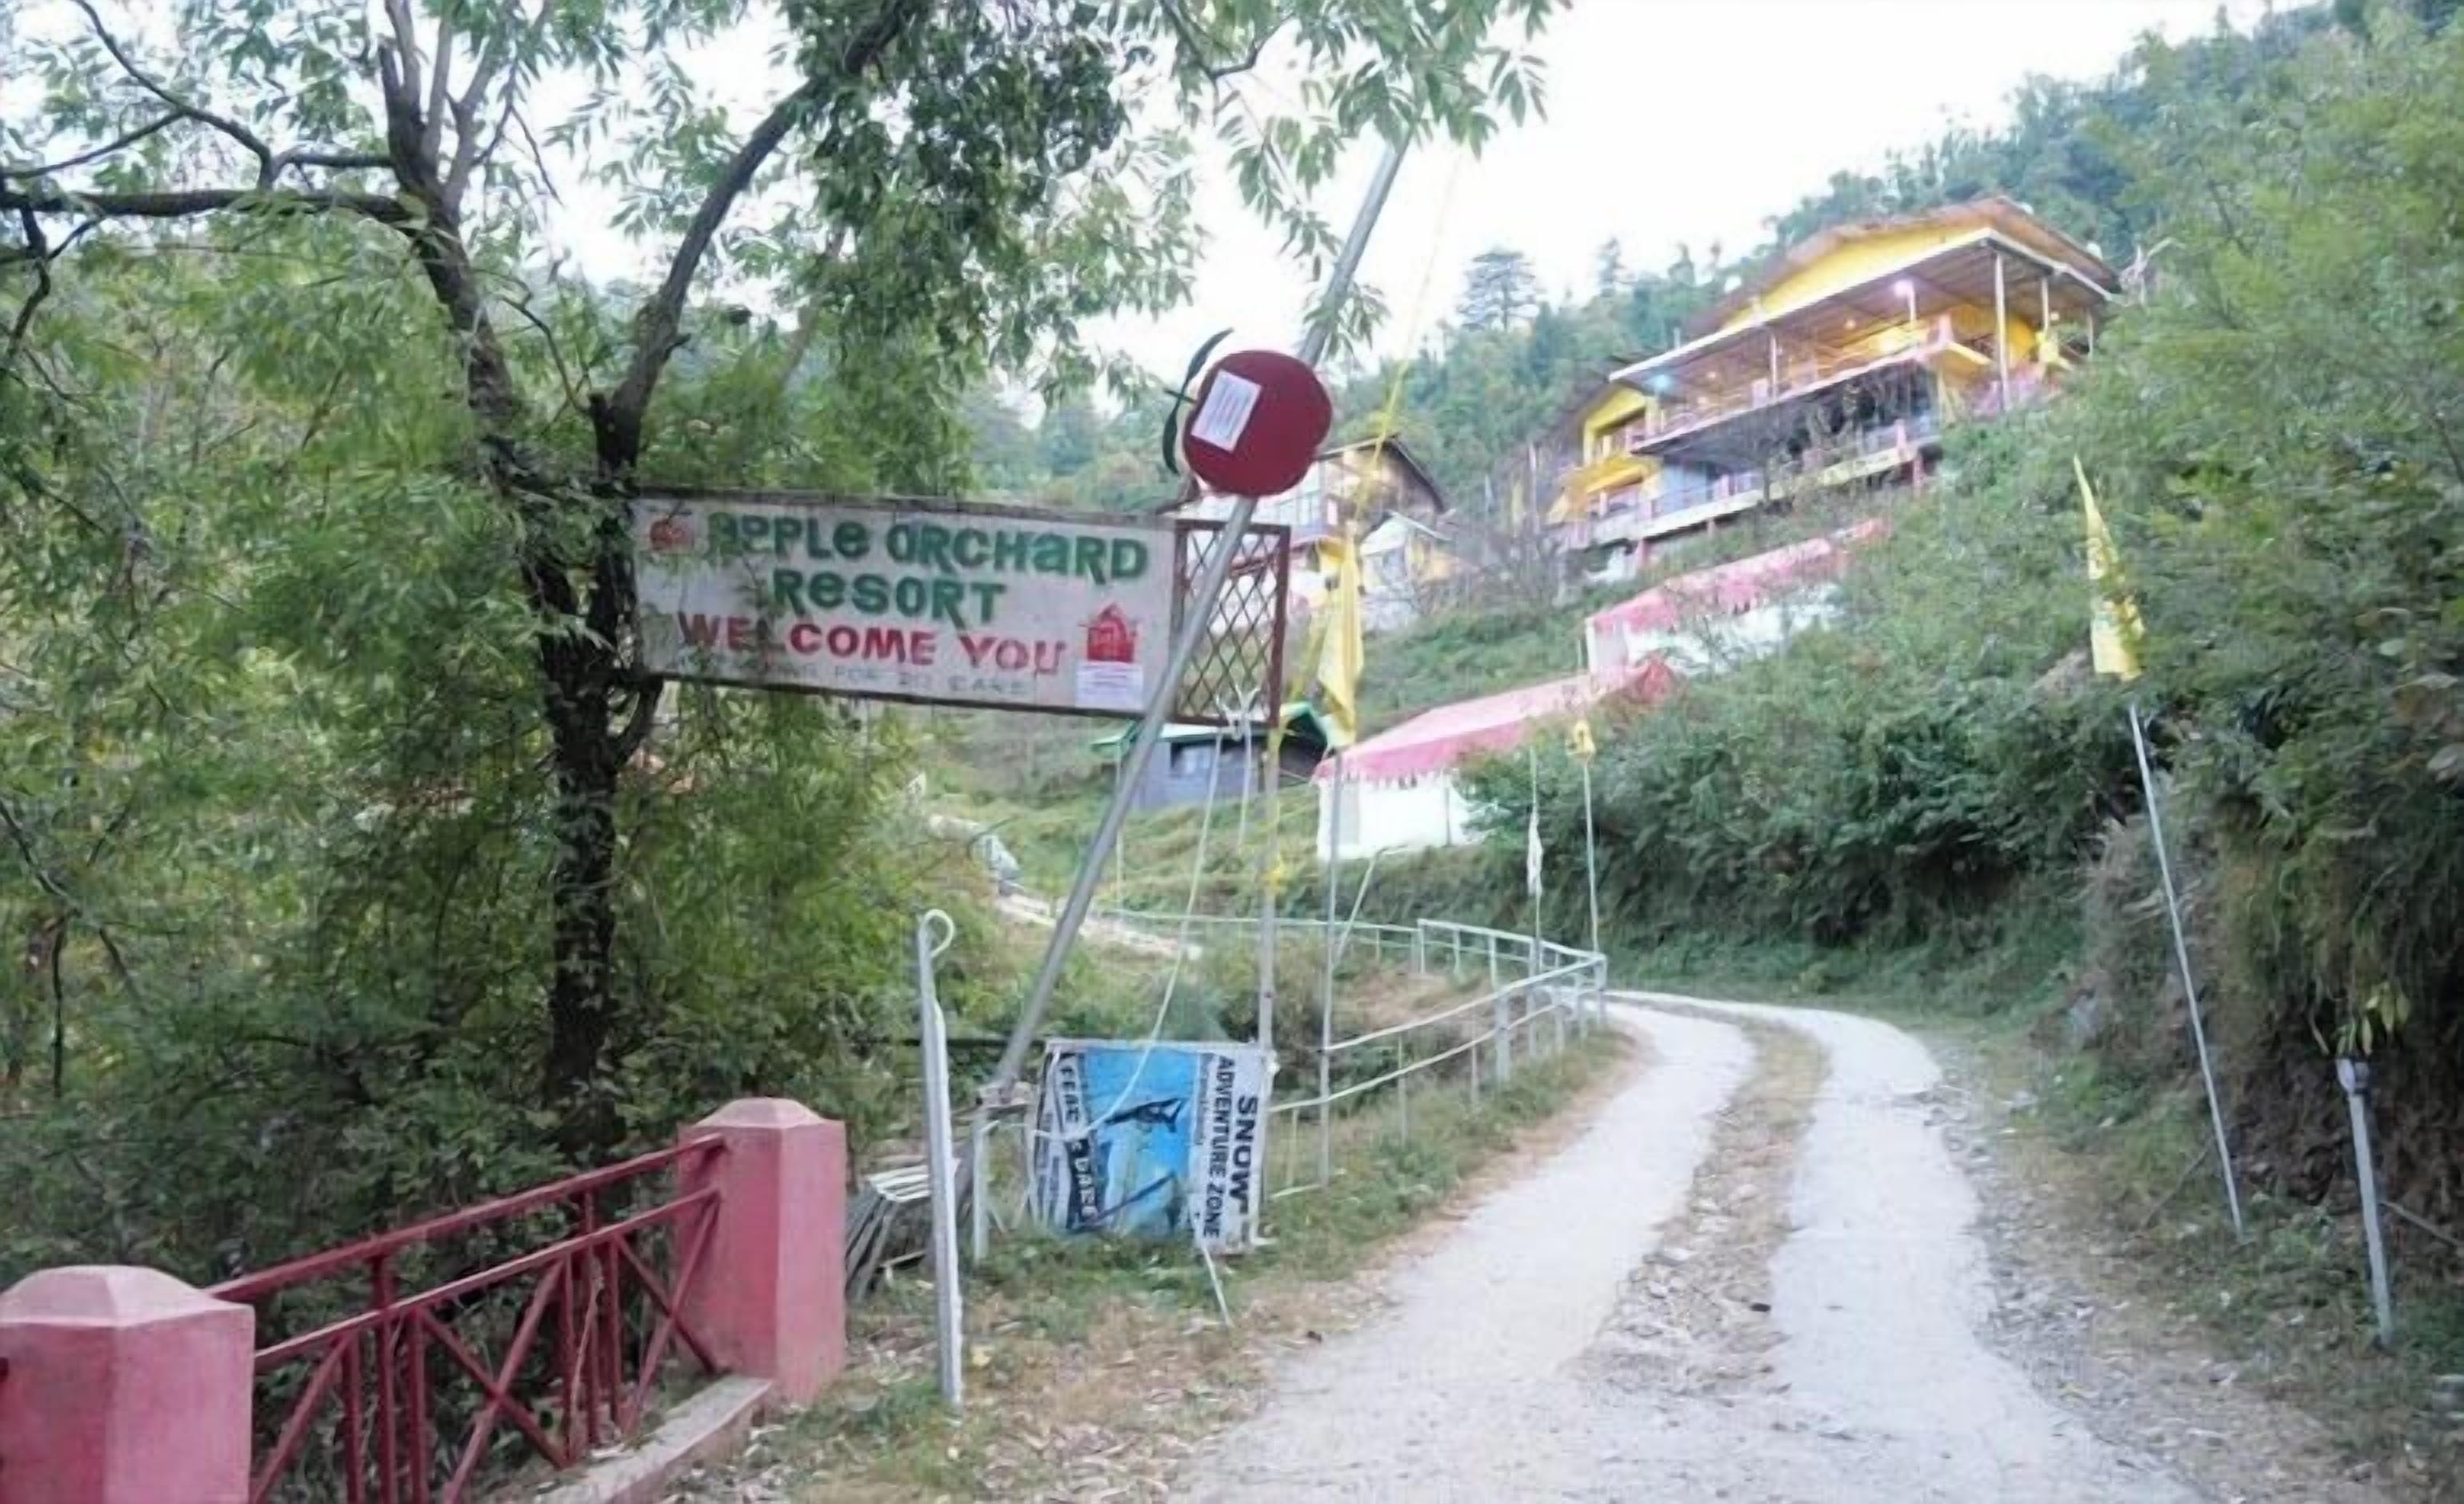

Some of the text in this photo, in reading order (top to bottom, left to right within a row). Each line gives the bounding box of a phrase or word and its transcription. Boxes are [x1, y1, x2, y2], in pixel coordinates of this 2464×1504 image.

[962, 636, 1066, 676] YOU
[1202, 1055, 1235, 1238] ADVENTURE ZONE
[1229, 1094, 1258, 1215] SNOW
